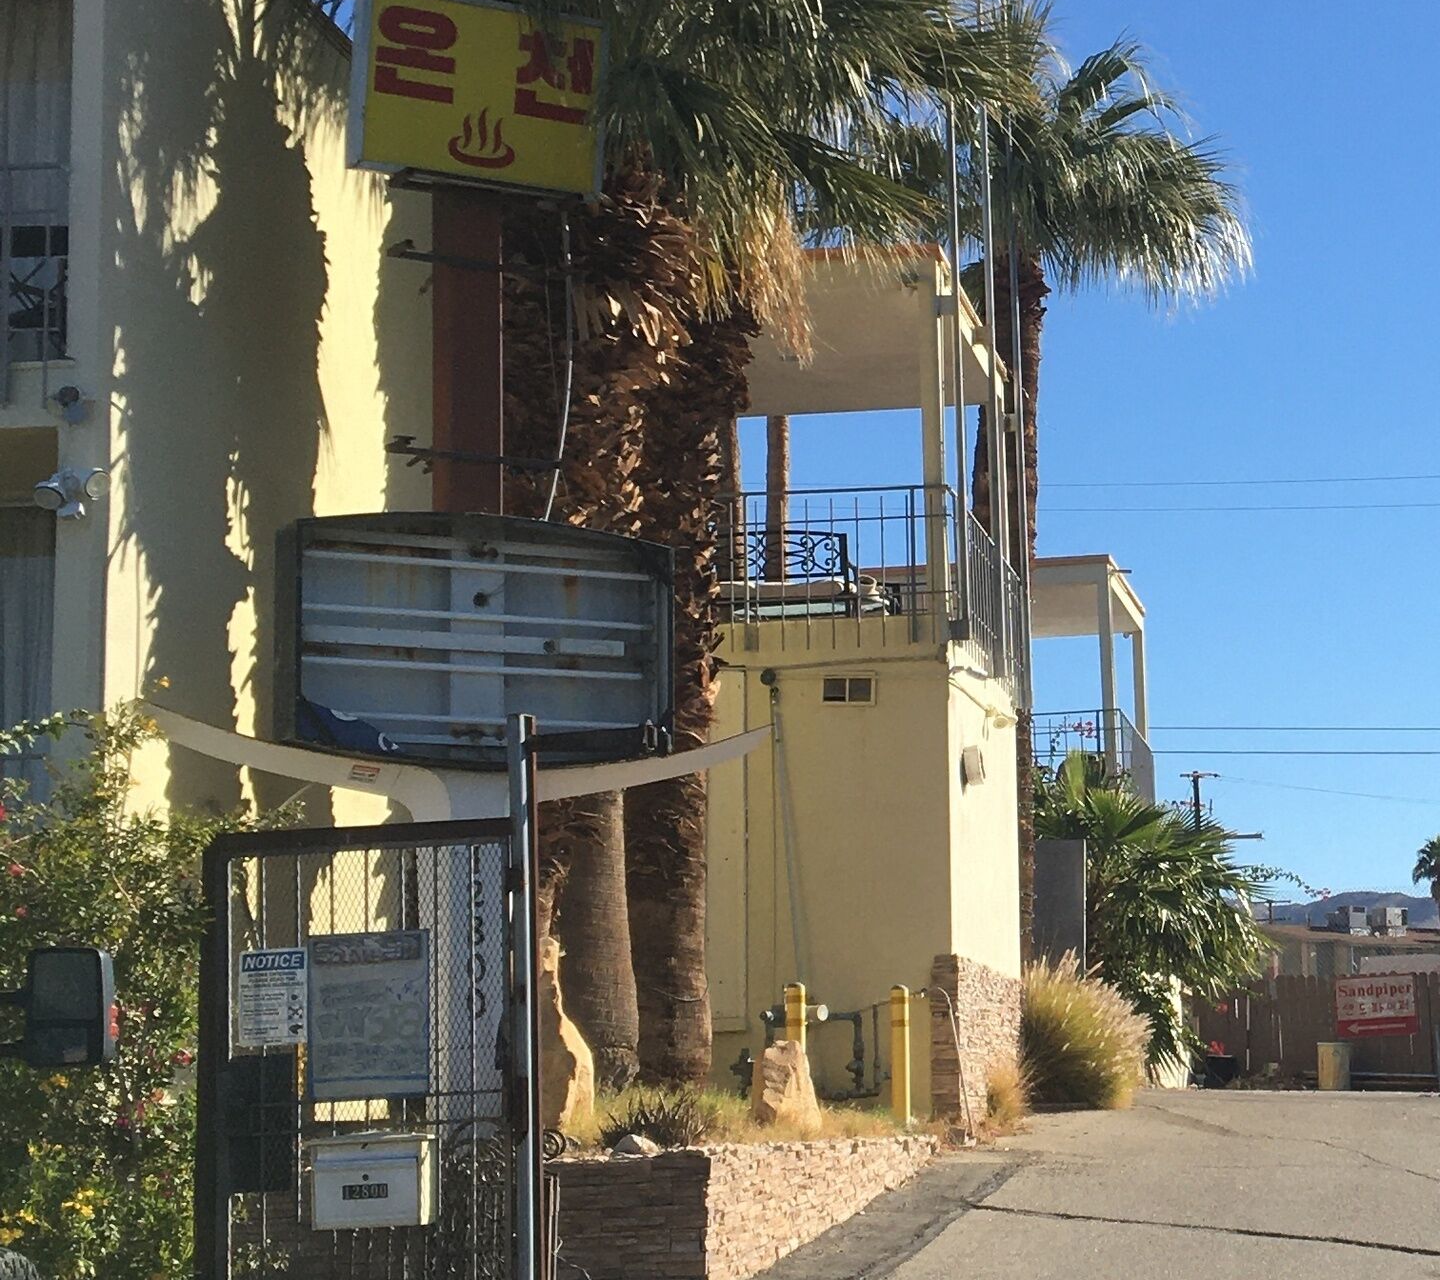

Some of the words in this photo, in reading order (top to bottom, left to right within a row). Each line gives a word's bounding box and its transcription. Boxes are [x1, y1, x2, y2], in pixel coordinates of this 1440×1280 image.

[244, 953, 302, 970] NOTICE
[1338, 982, 1412, 998] Sandpiper
[345, 1183, 387, 1200] 12800
